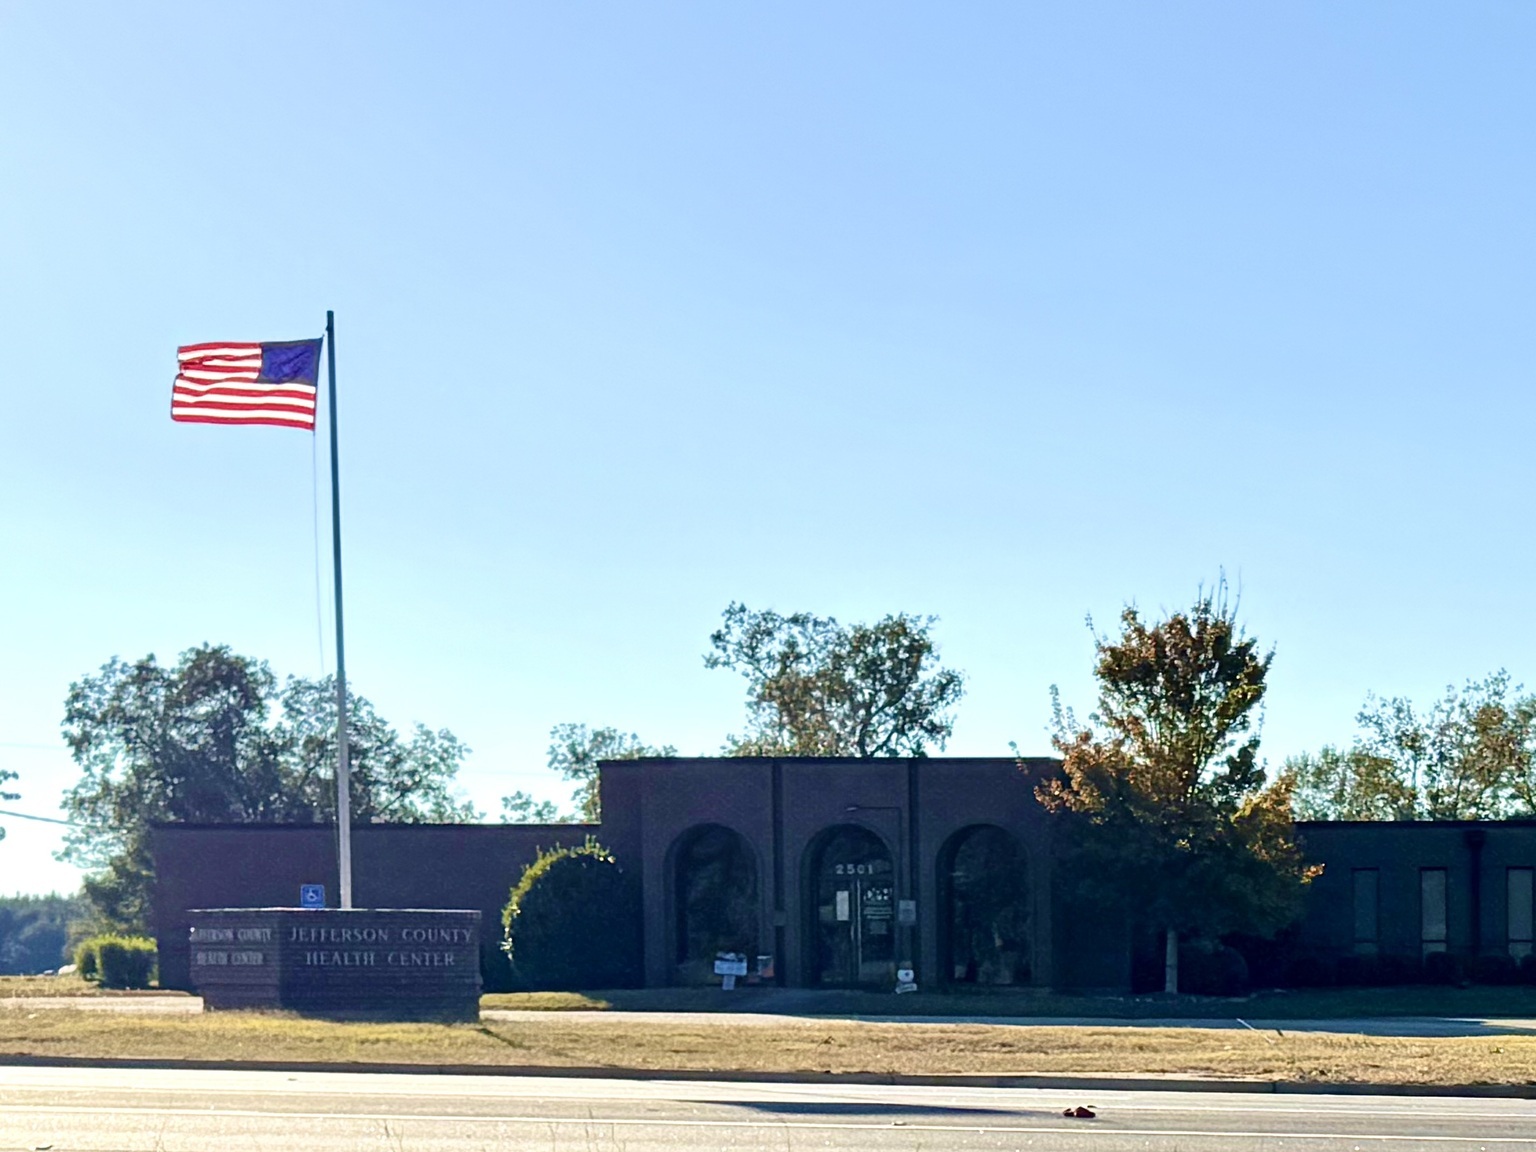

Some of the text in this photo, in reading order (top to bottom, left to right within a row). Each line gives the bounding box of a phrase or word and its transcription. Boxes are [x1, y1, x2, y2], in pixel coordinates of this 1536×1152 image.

[289, 927, 472, 942] JEFFERSON COUNTY
[305, 951, 455, 966] HEALTH CENTER
